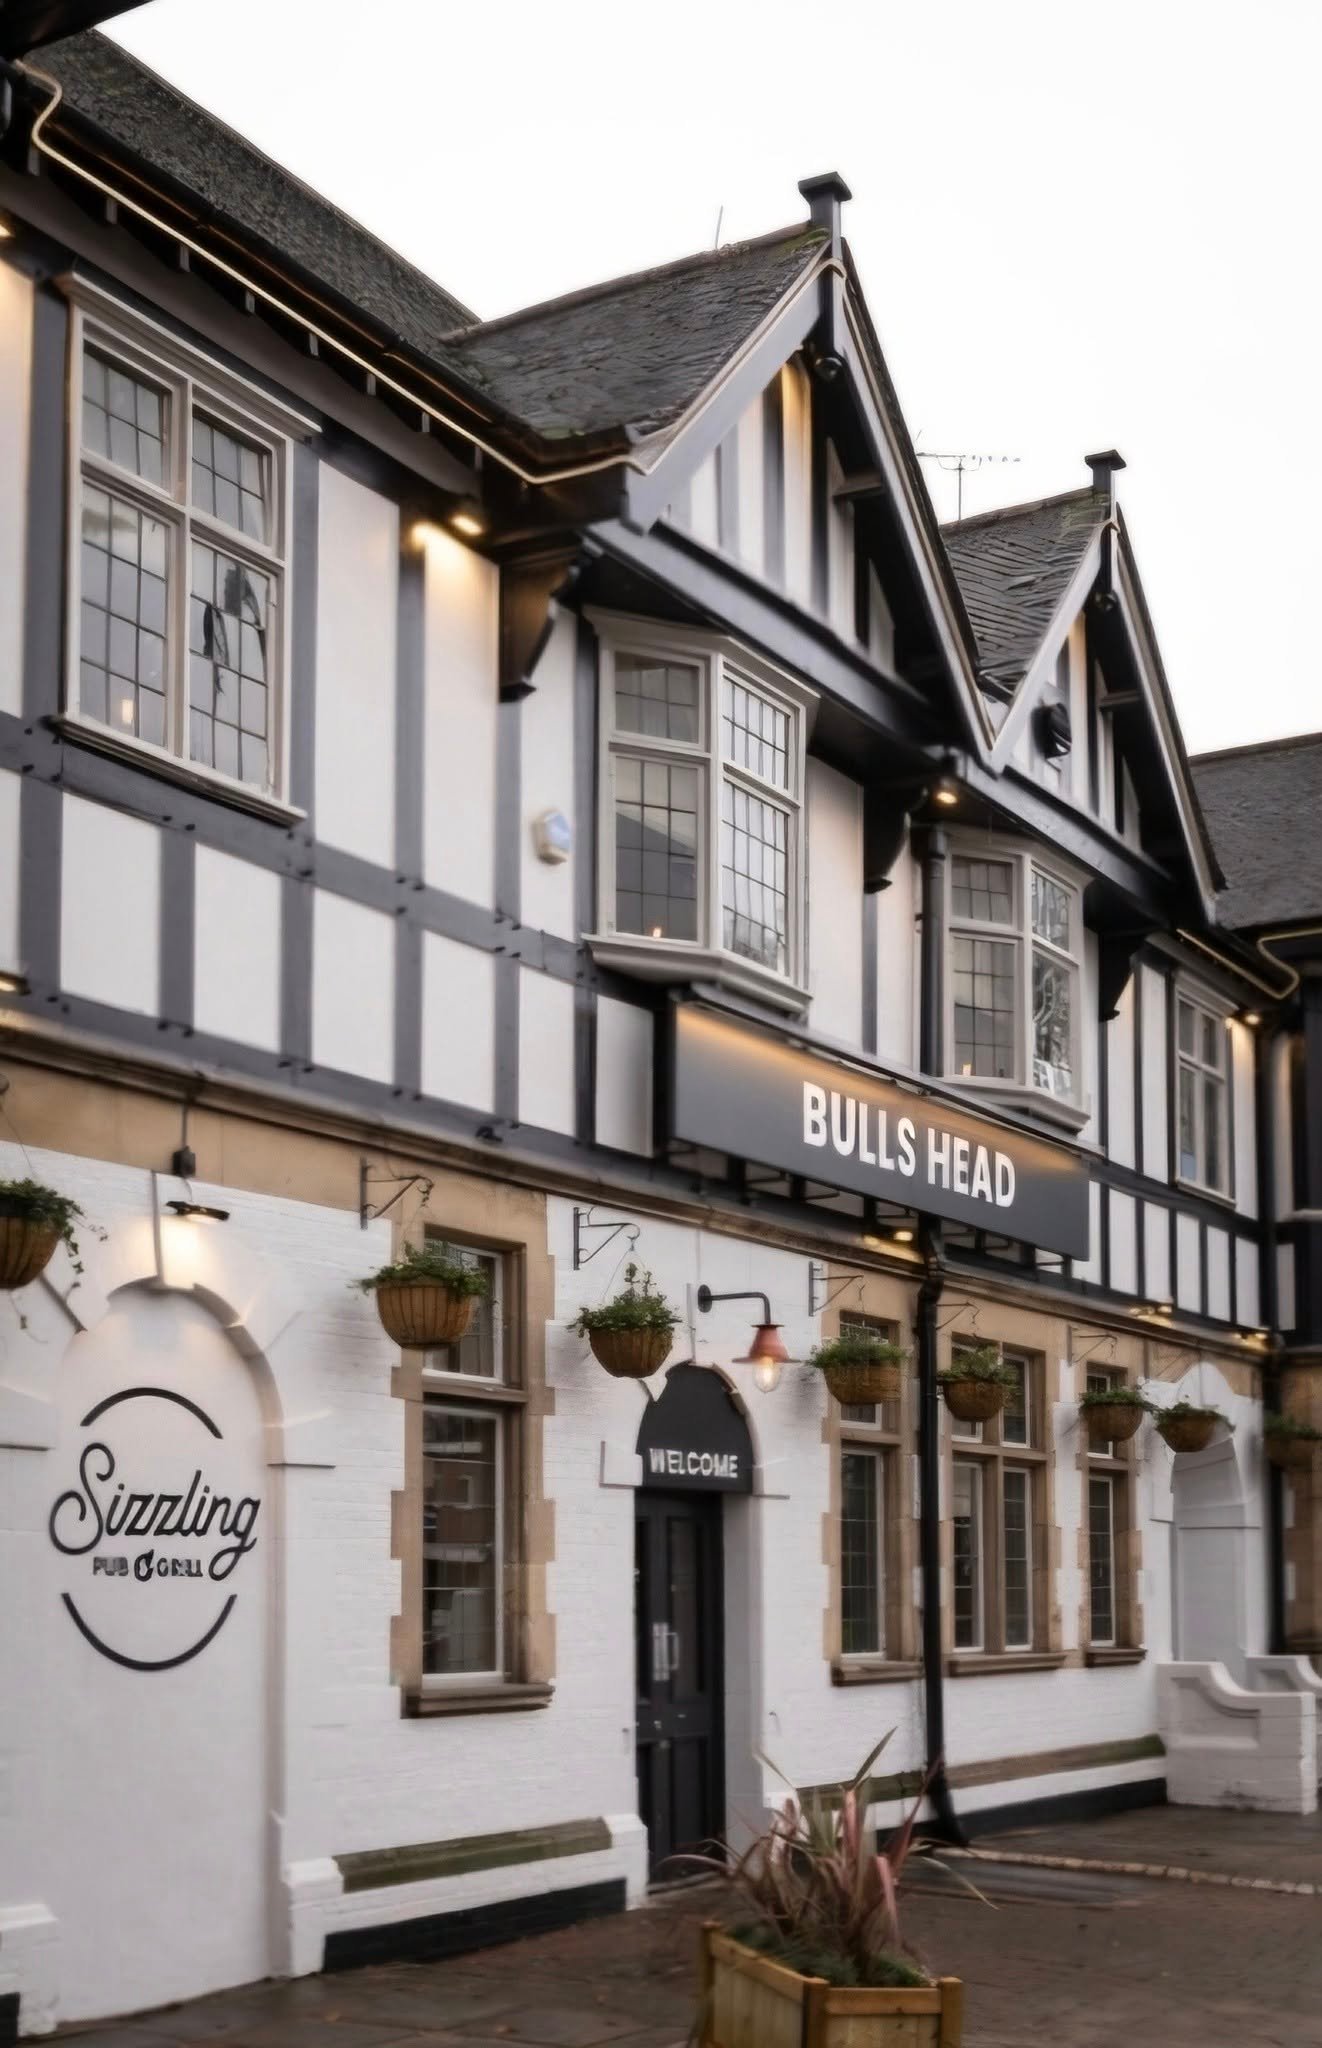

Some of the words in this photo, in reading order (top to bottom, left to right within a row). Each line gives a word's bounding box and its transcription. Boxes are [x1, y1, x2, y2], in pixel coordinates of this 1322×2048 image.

[803, 1081, 916, 1176] BULLS
[927, 1127, 1016, 1207] HEAD
[49, 1442, 261, 1581] Sizzling
[649, 1447, 738, 1478] WELCOME
